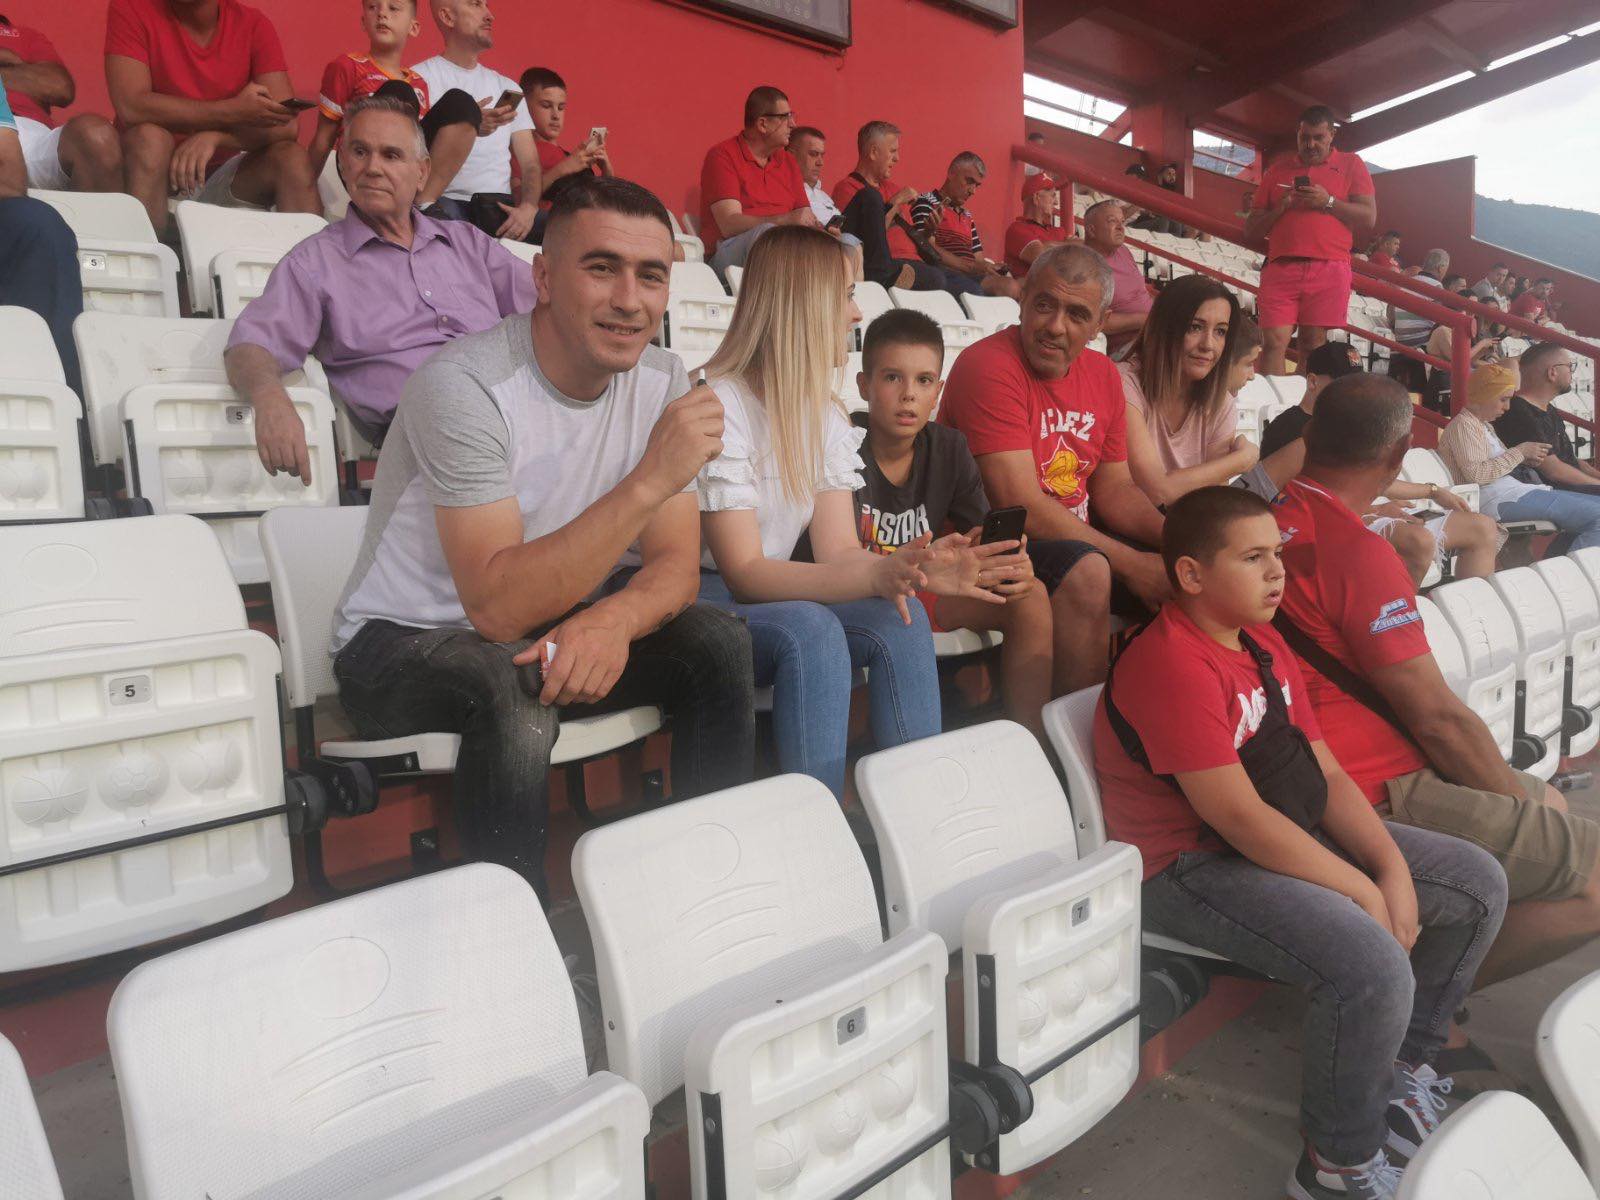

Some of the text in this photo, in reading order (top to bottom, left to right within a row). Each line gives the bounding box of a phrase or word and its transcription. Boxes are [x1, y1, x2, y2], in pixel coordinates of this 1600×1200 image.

[235, 411, 243, 421] 5
[124, 684, 136, 698] 5
[1076, 905, 1084, 919] 7
[846, 1018, 855, 1034] 6
